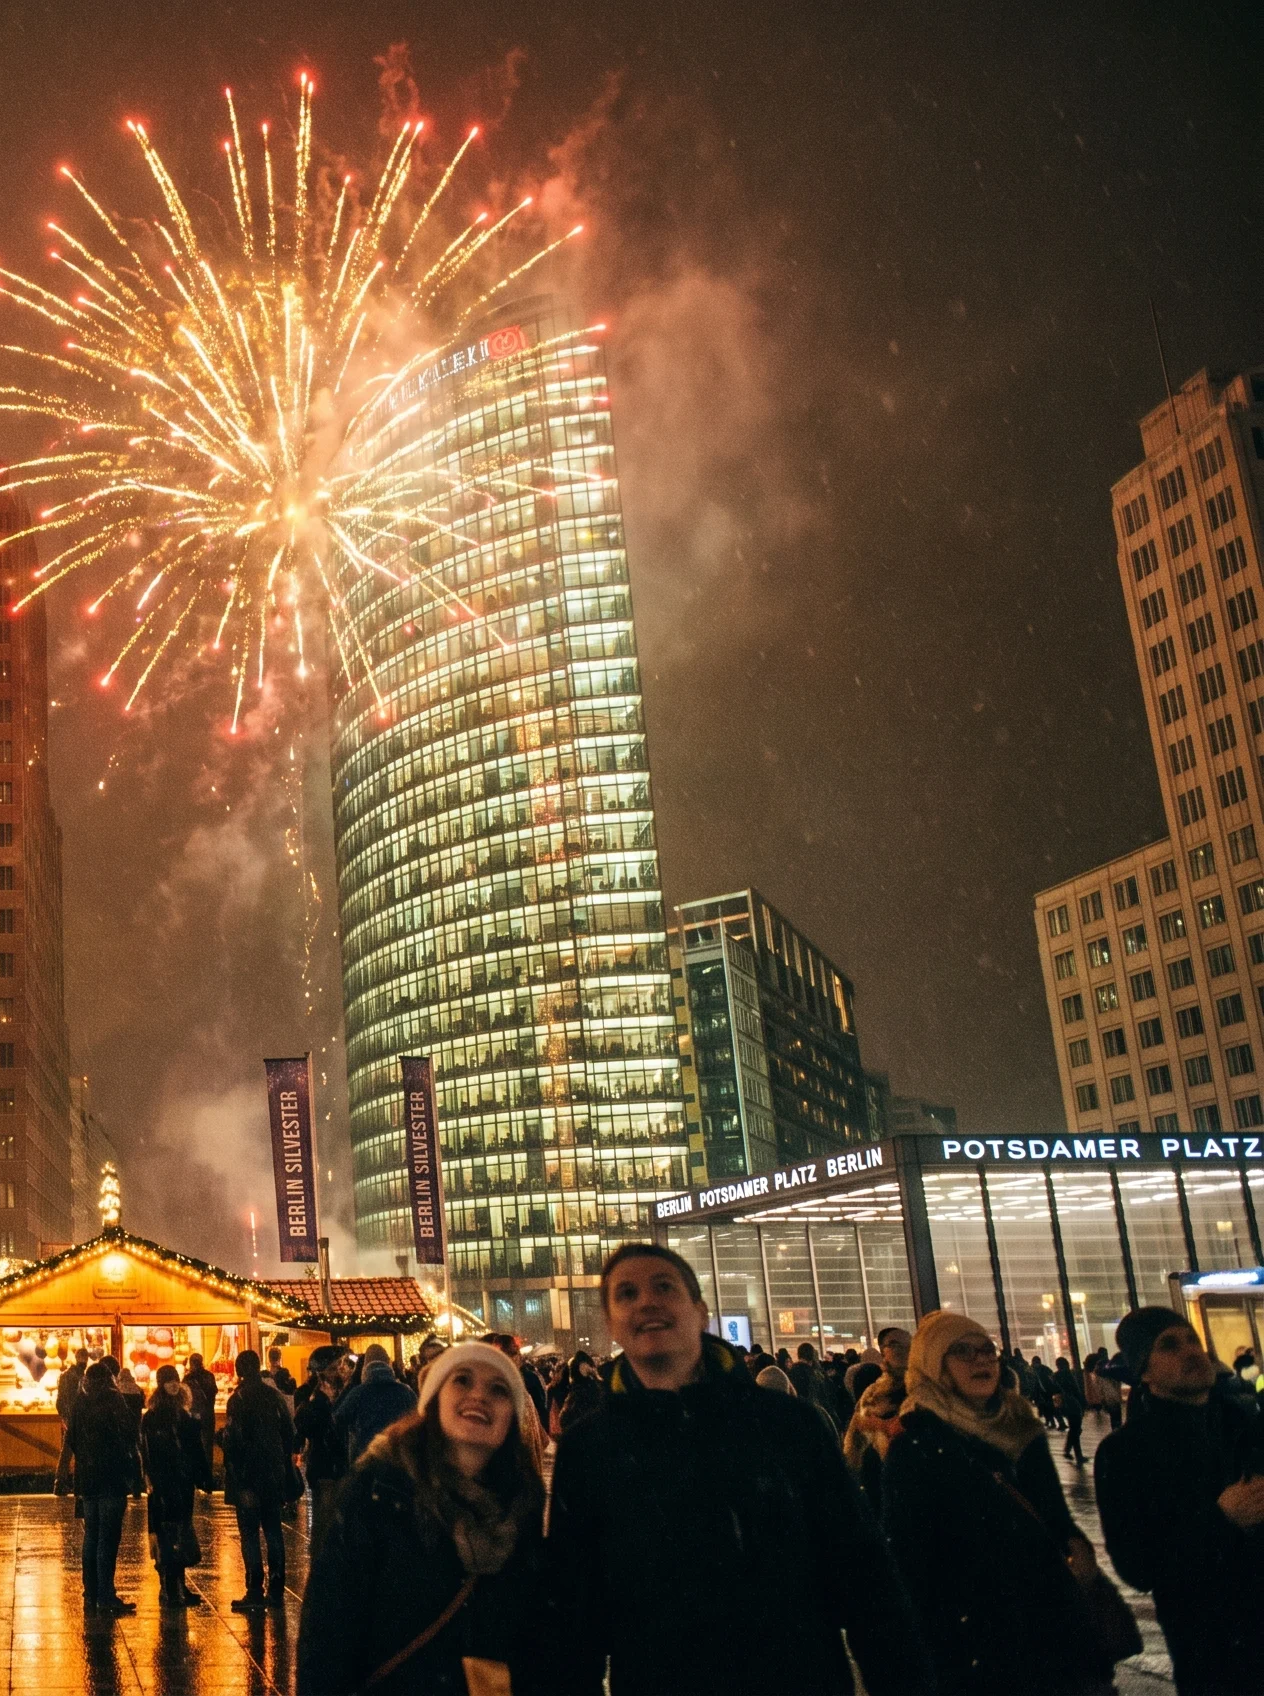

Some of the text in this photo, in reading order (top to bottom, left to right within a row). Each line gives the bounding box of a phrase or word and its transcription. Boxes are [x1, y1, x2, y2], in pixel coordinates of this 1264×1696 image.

[280, 1091, 307, 1237] BERLIN SILVESTER
[410, 1091, 435, 1238] BERLIN SILVESTER
[656, 1147, 883, 1219] BERLIN POTSDAMER PLATZ BERLIN
[942, 1137, 1263, 1159] POTSDAMER PLATZ
